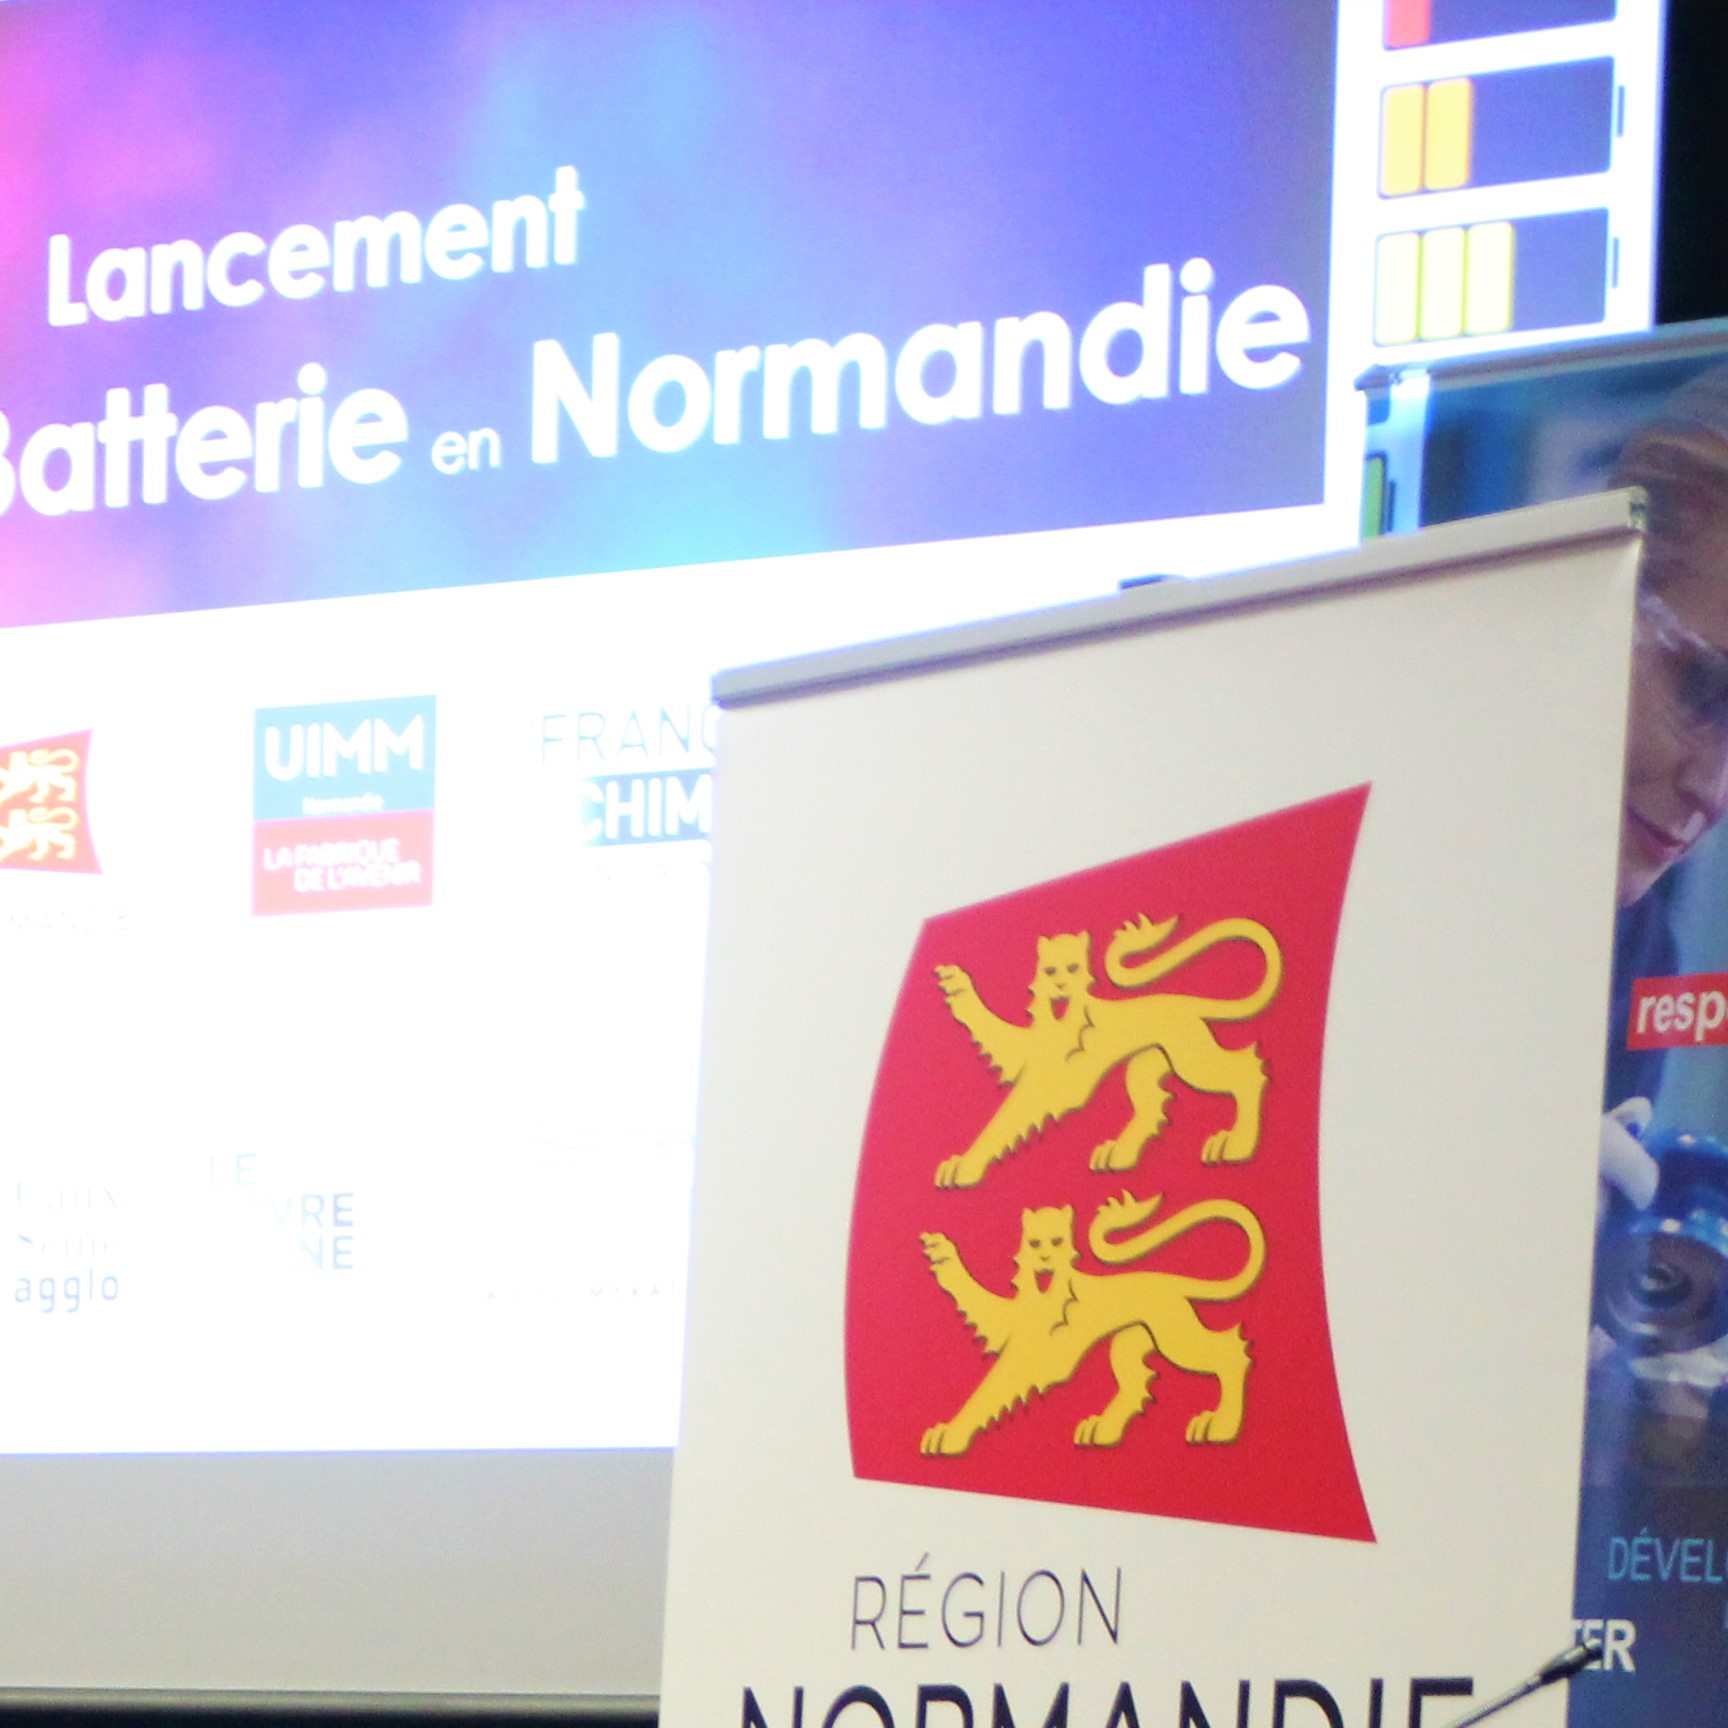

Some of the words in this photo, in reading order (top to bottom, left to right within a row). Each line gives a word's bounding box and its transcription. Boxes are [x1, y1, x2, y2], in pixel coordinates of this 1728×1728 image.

[47, 164, 585, 328] Lancement
[430, 427, 502, 475] en
[530, 256, 1311, 465] Normandie
[263, 713, 424, 782] UIMM
[541, 702, 717, 766] FRANC
[577, 773, 713, 839] CHIM
[1635, 989, 1728, 1043] resp
[13, 1264, 120, 1314] agglo
[1606, 1526, 1728, 1583] DÉVEL
[849, 1552, 1123, 1651] RÉGION
